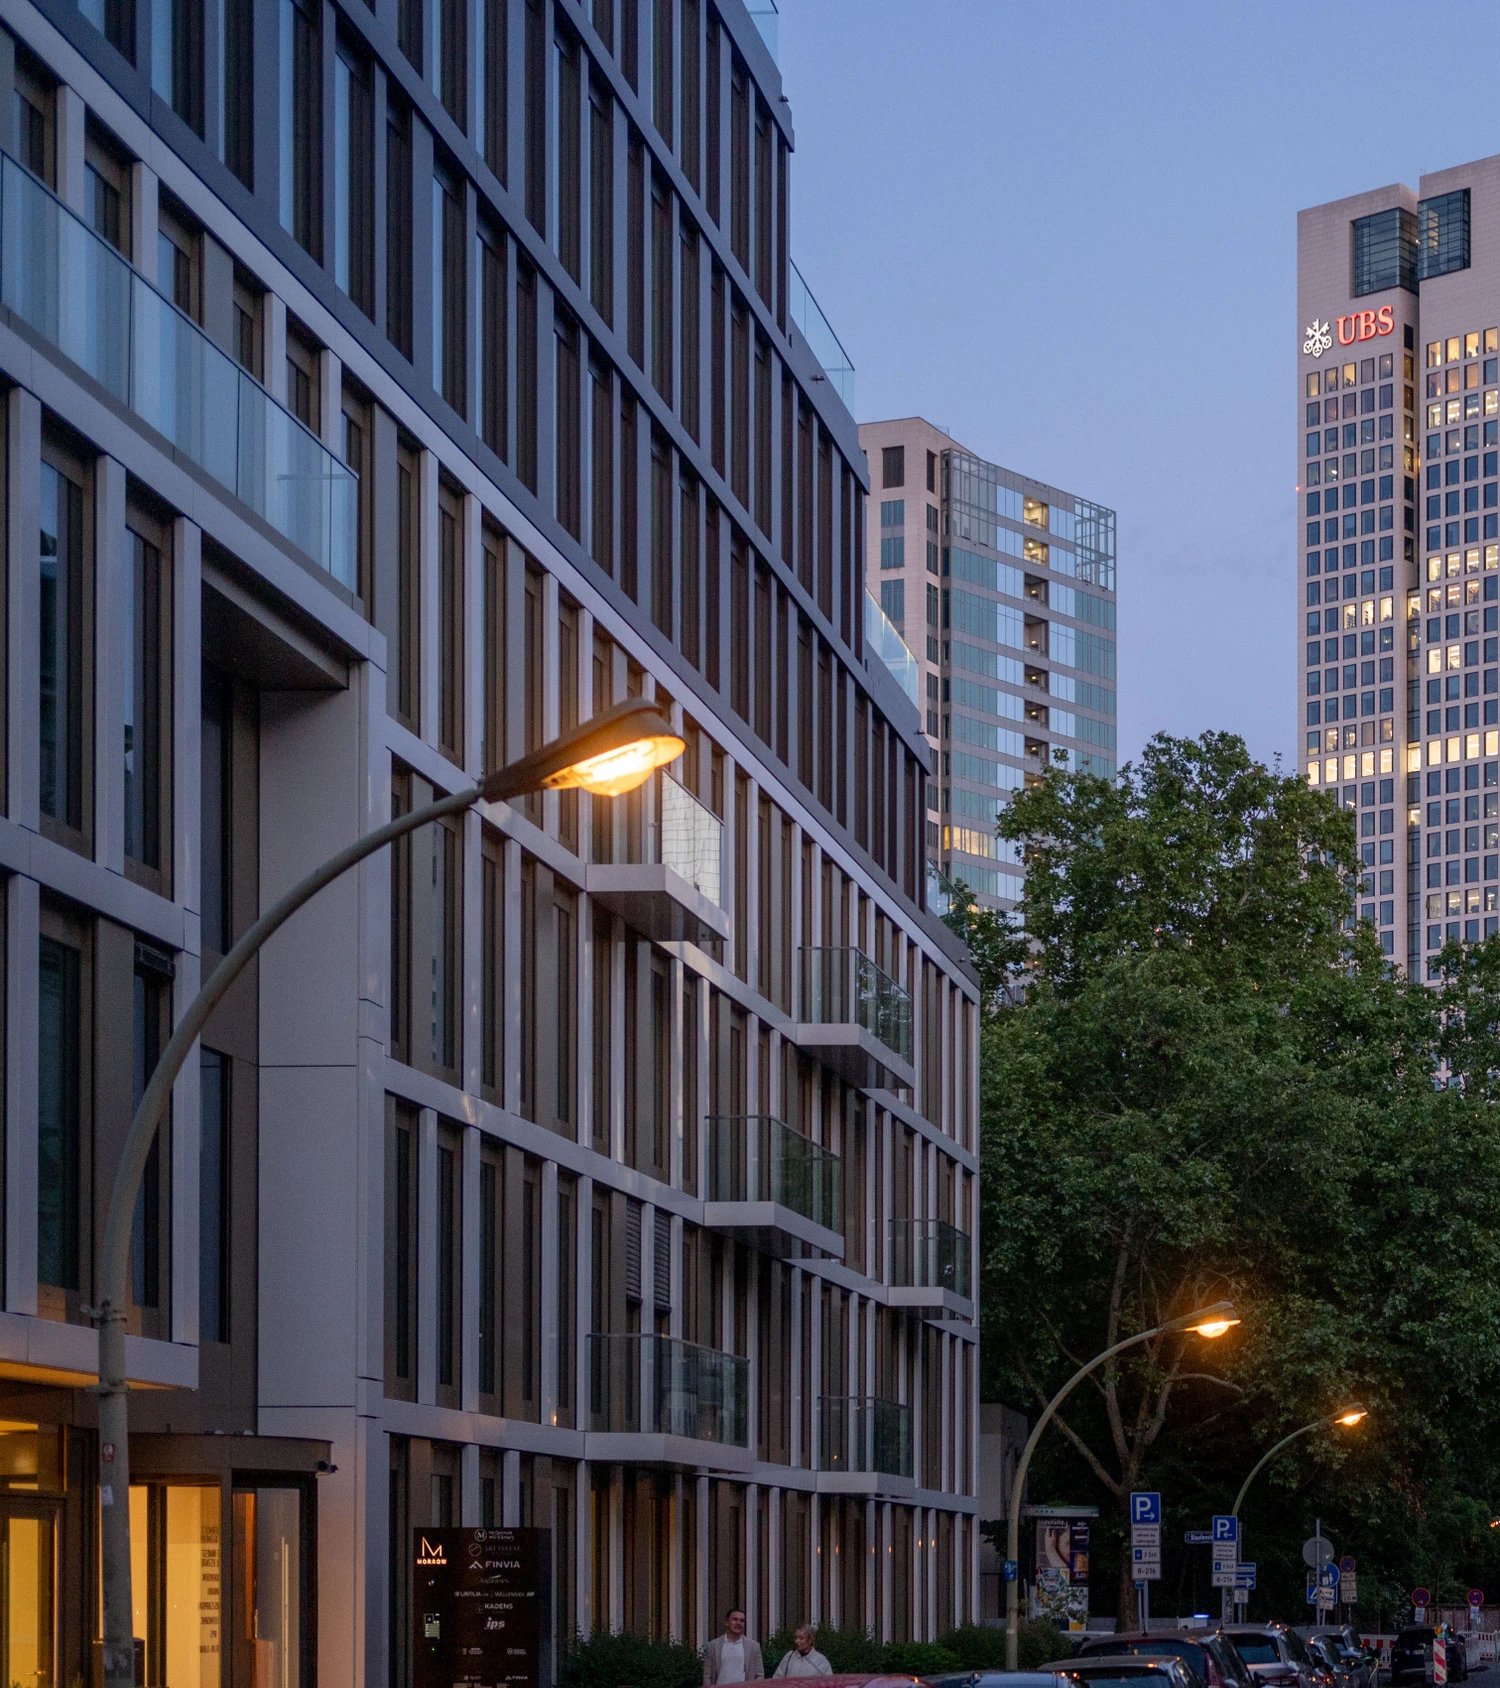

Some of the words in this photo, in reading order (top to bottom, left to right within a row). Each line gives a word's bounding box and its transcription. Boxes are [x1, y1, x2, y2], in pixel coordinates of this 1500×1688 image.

[1336, 306, 1395, 345] UBS
[1136, 1497, 1152, 1521] P
[1217, 1519, 1230, 1539] P
[486, 1617, 506, 1630] ips
